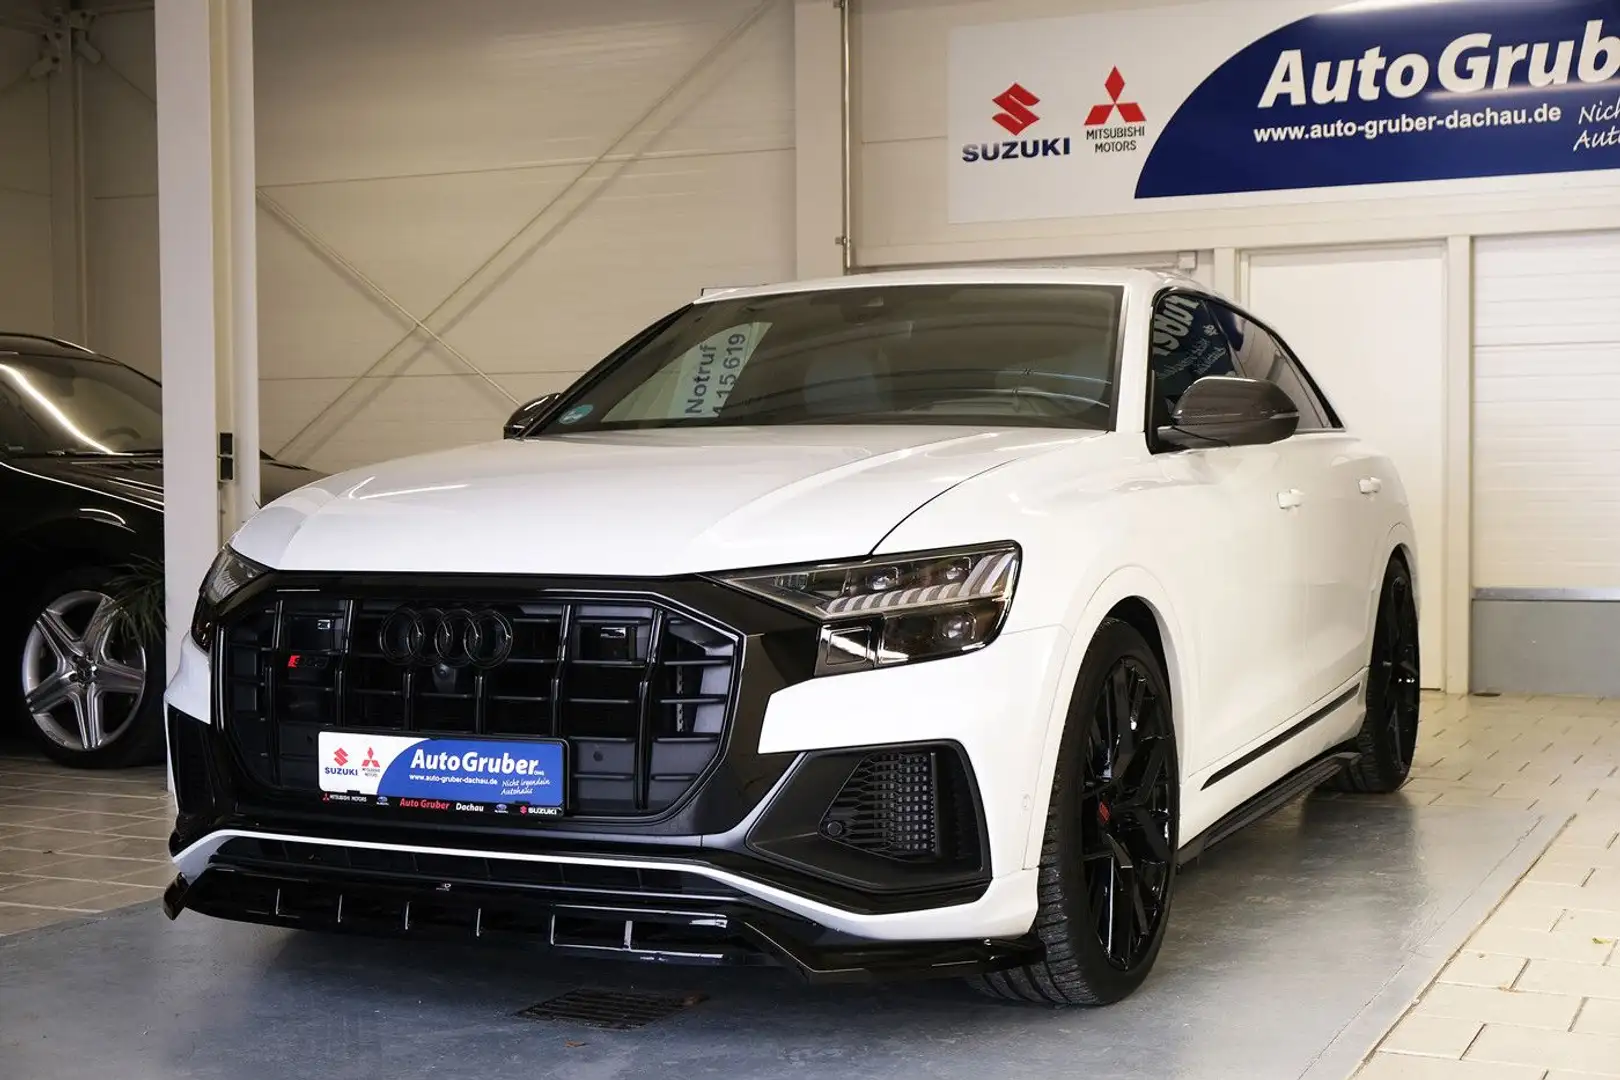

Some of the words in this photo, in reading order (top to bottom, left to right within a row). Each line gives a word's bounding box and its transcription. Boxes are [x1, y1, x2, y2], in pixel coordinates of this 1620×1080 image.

[1254, 103, 1562, 143] www.auto-gruber-dachau.de
[1086, 125, 1145, 140] MITSUBISHI
[1573, 125, 1620, 151] Aut
[962, 136, 1071, 162] SUZUKI
[1094, 139, 1137, 153] MOTORS
[685, 344, 717, 414] Notruf
[324, 766, 358, 776] SUZUKI
[409, 774, 498, 786] www.auto-gruber-dachau.de
[400, 798, 419, 807] Auto
[420, 799, 450, 809] Gruber
[455, 802, 484, 812] Dachau
[528, 807, 557, 815] SUZUKI
